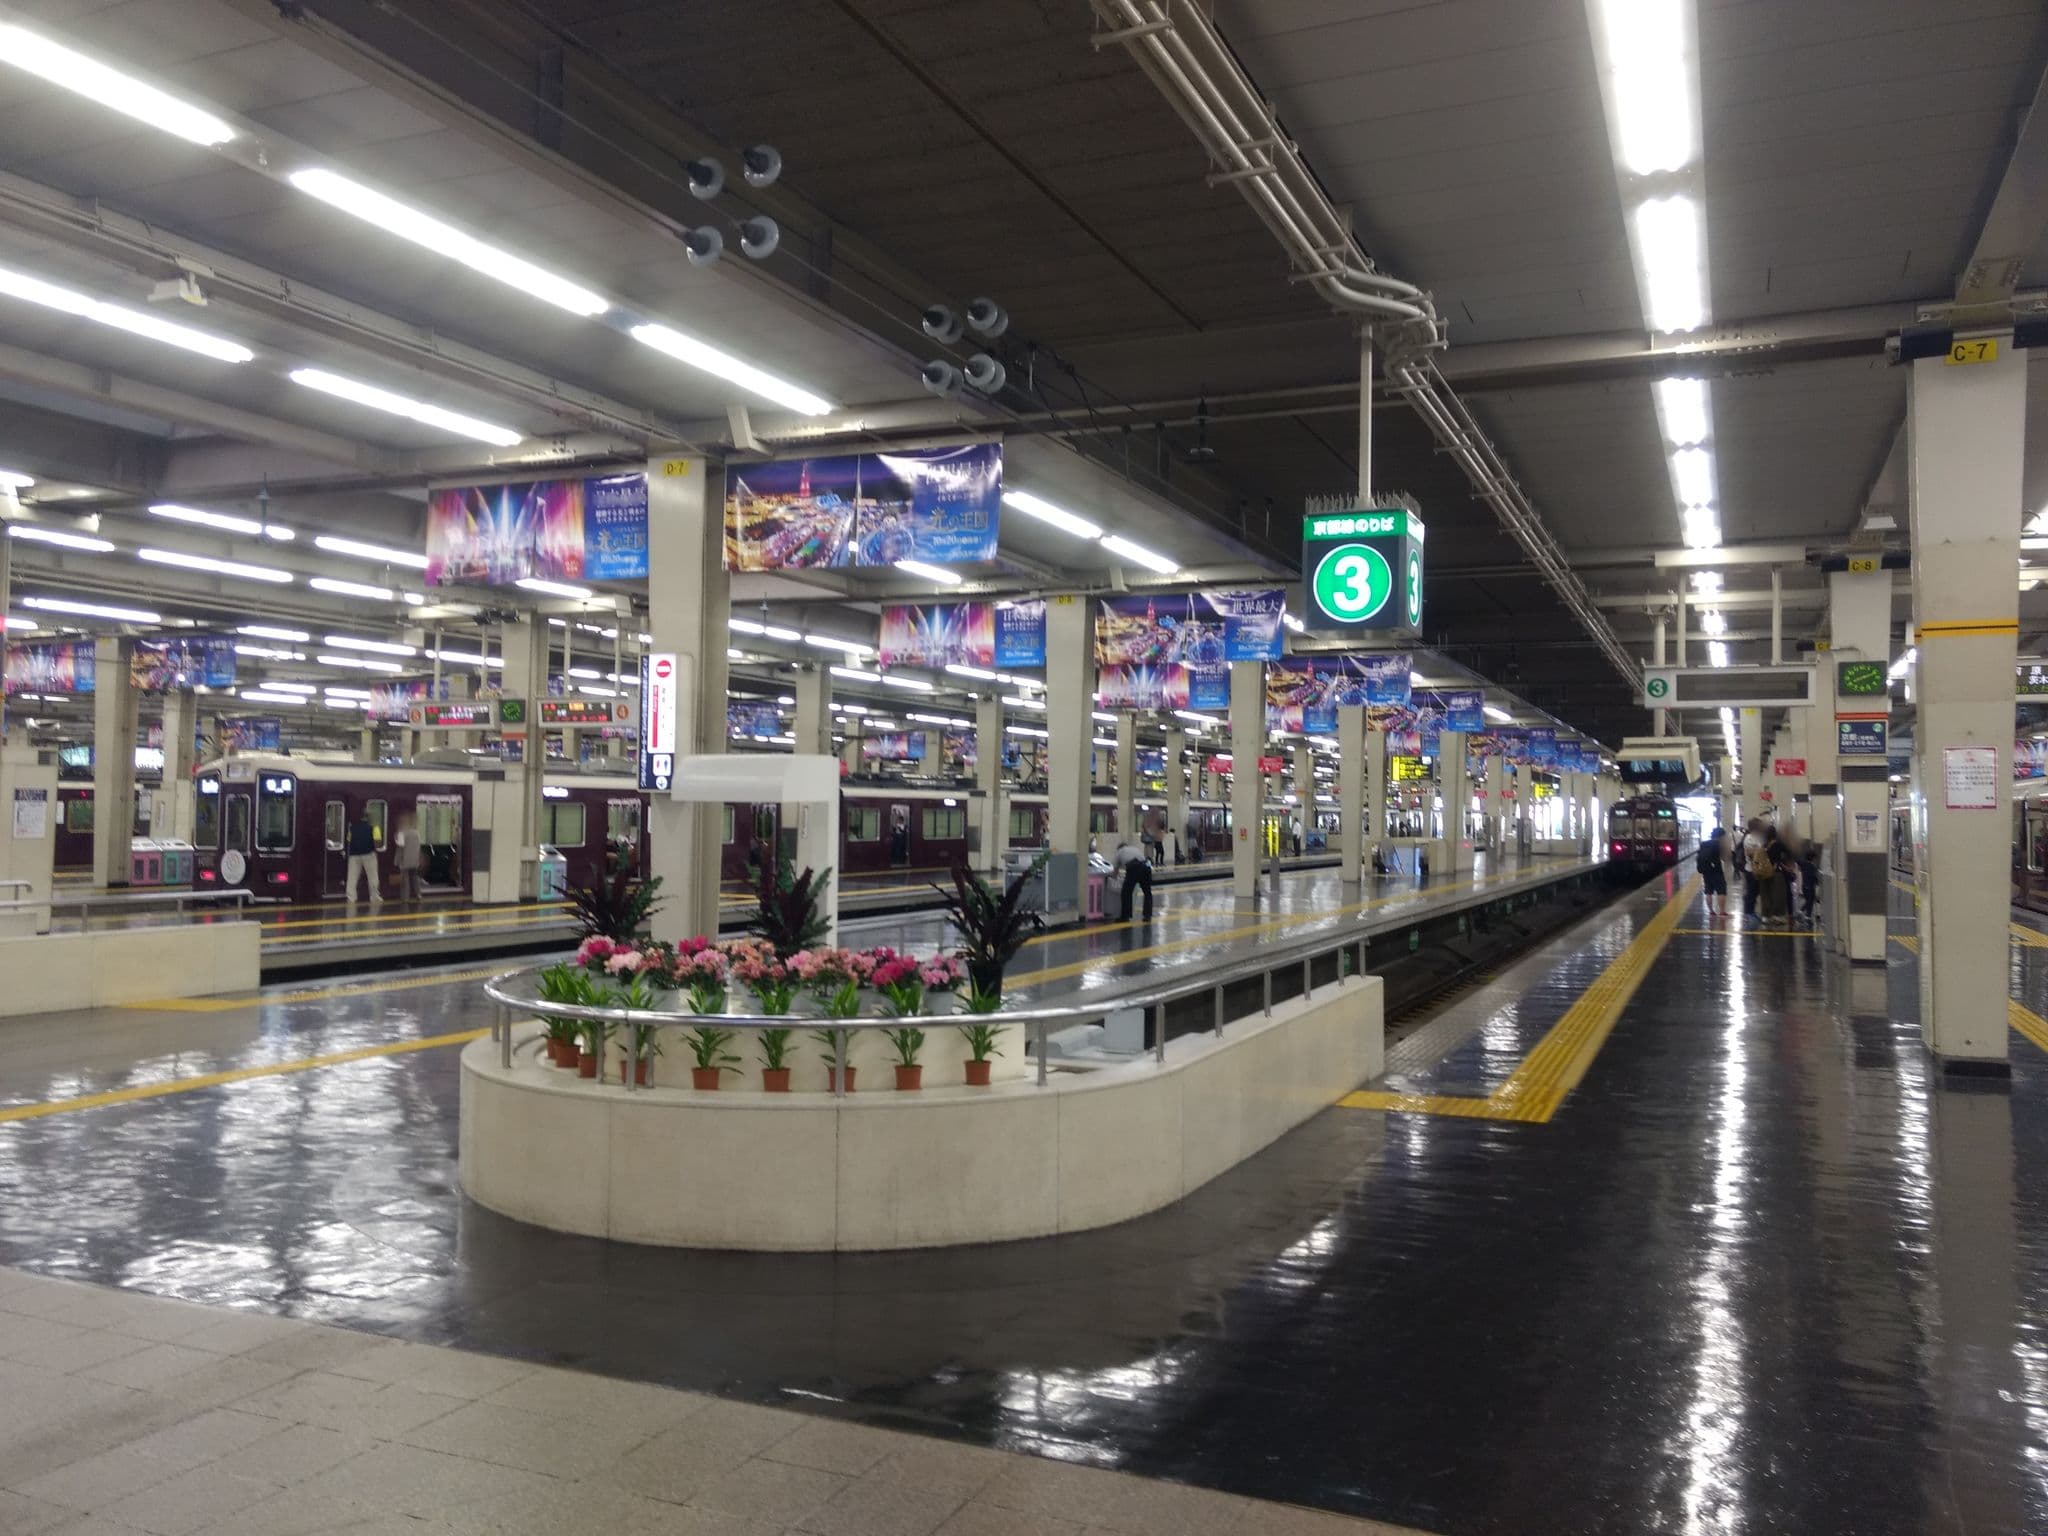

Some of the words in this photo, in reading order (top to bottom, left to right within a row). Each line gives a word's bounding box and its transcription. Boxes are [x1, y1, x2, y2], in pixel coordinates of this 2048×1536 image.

[1954, 343, 1988, 361] C-7
[1333, 555, 1372, 612] 3
[1409, 560, 1419, 616] 3
[1653, 681, 1664, 697] 3
